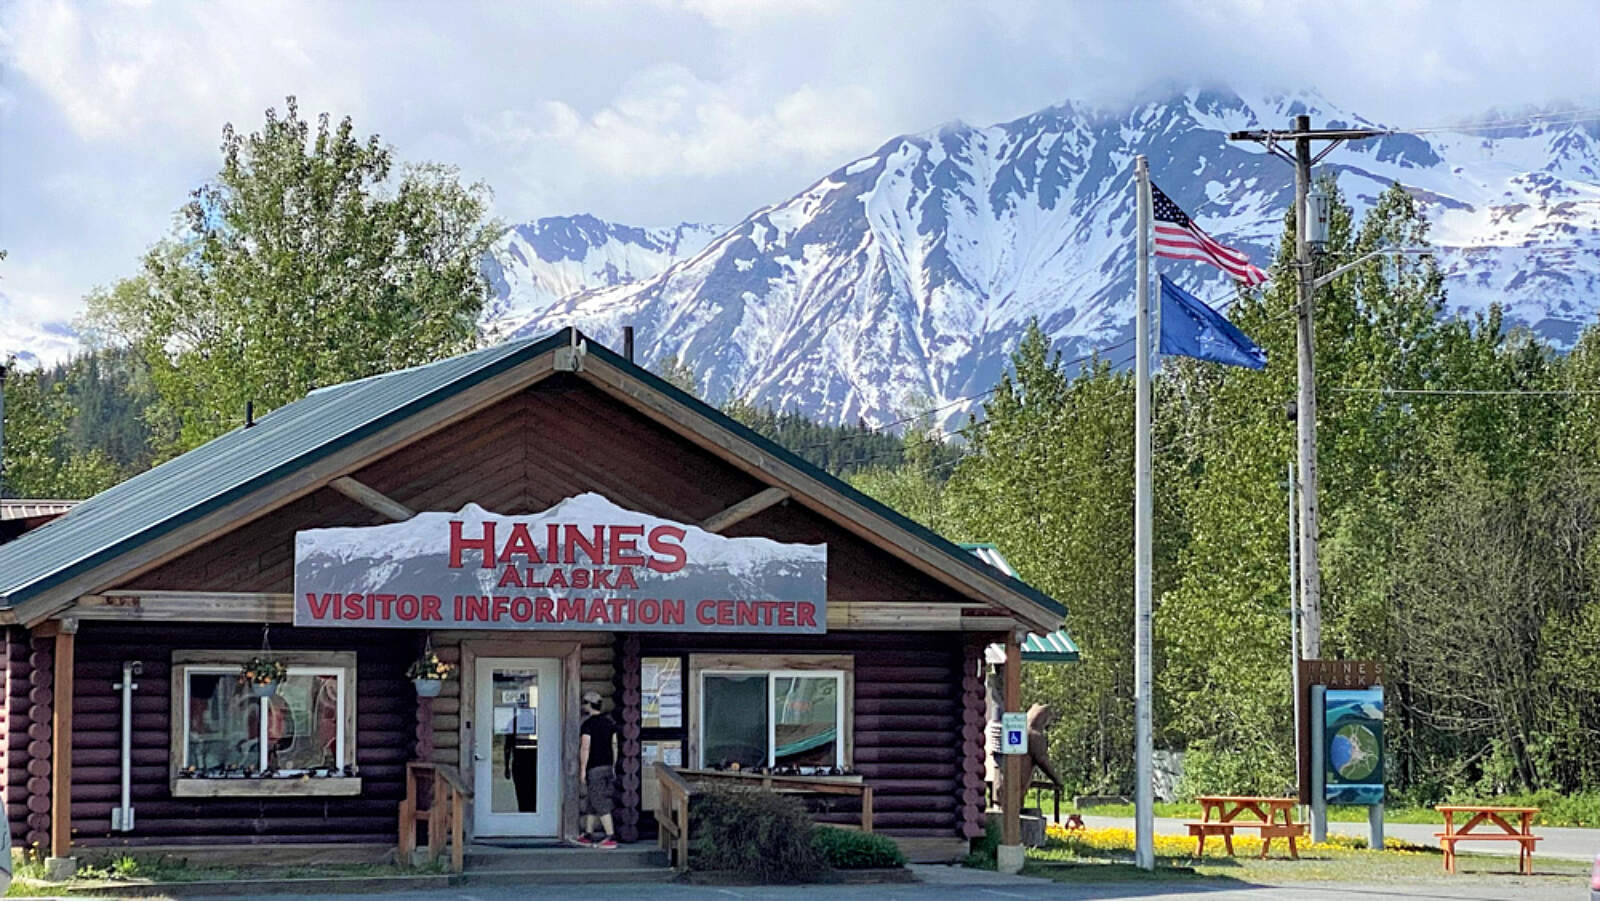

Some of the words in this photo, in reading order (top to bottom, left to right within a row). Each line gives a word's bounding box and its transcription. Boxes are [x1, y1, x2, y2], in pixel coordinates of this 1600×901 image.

[449, 521, 688, 573] HAINES
[498, 564, 639, 590] ALASKA
[306, 593, 442, 620] VISITOR
[453, 595, 686, 624] INFORMATION
[695, 599, 817, 627] CENTER
